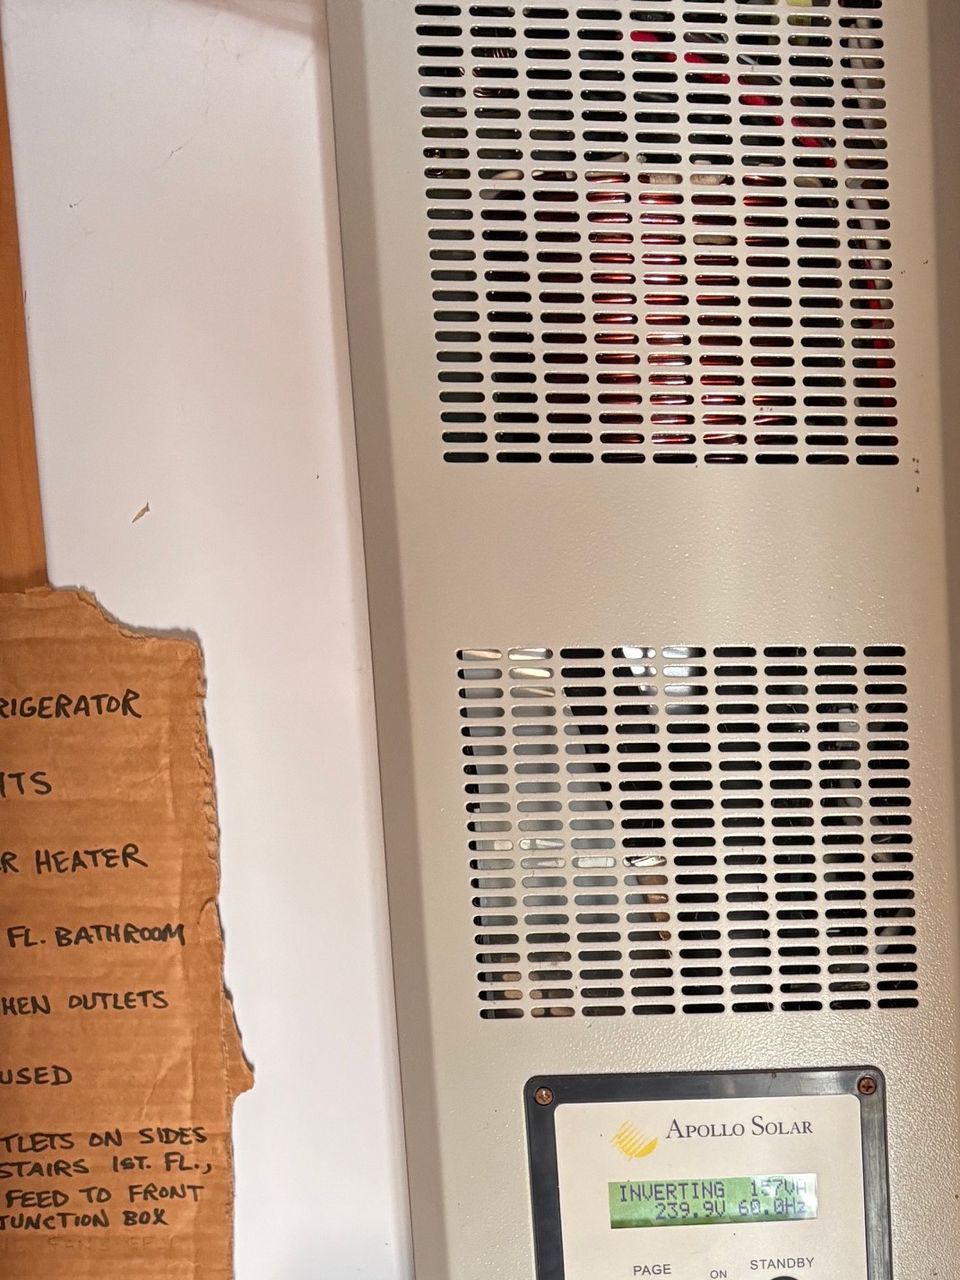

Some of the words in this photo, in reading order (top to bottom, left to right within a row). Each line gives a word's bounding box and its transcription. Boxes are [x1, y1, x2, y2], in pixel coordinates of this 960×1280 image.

[35, 843, 148, 875] HEATER
[7, 925, 46, 948] FL.
[55, 923, 186, 948] BATHROOM
[68, 990, 169, 1010] OUTLETS
[89, 1128, 122, 1147] ON
[139, 1127, 207, 1146] SIDES
[665, 1118, 745, 1139] APOLLO
[751, 1115, 814, 1136] SOLAR
[0, 1158, 89, 1178] STAIRS
[6, 1189, 69, 1208] FEED
[79, 1186, 112, 1203] TO
[129, 1183, 204, 1203] FRONT
[619, 1181, 725, 1202] INVERTING
[123, 1207, 168, 1226] BOX
[655, 1201, 725, 1220] 239.9V
[738, 1197, 806, 1217] 60.0Hz
[633, 1263, 672, 1276] PAGE
[710, 1269, 727, 1279] ON
[750, 1257, 815, 1271] STANDBY
